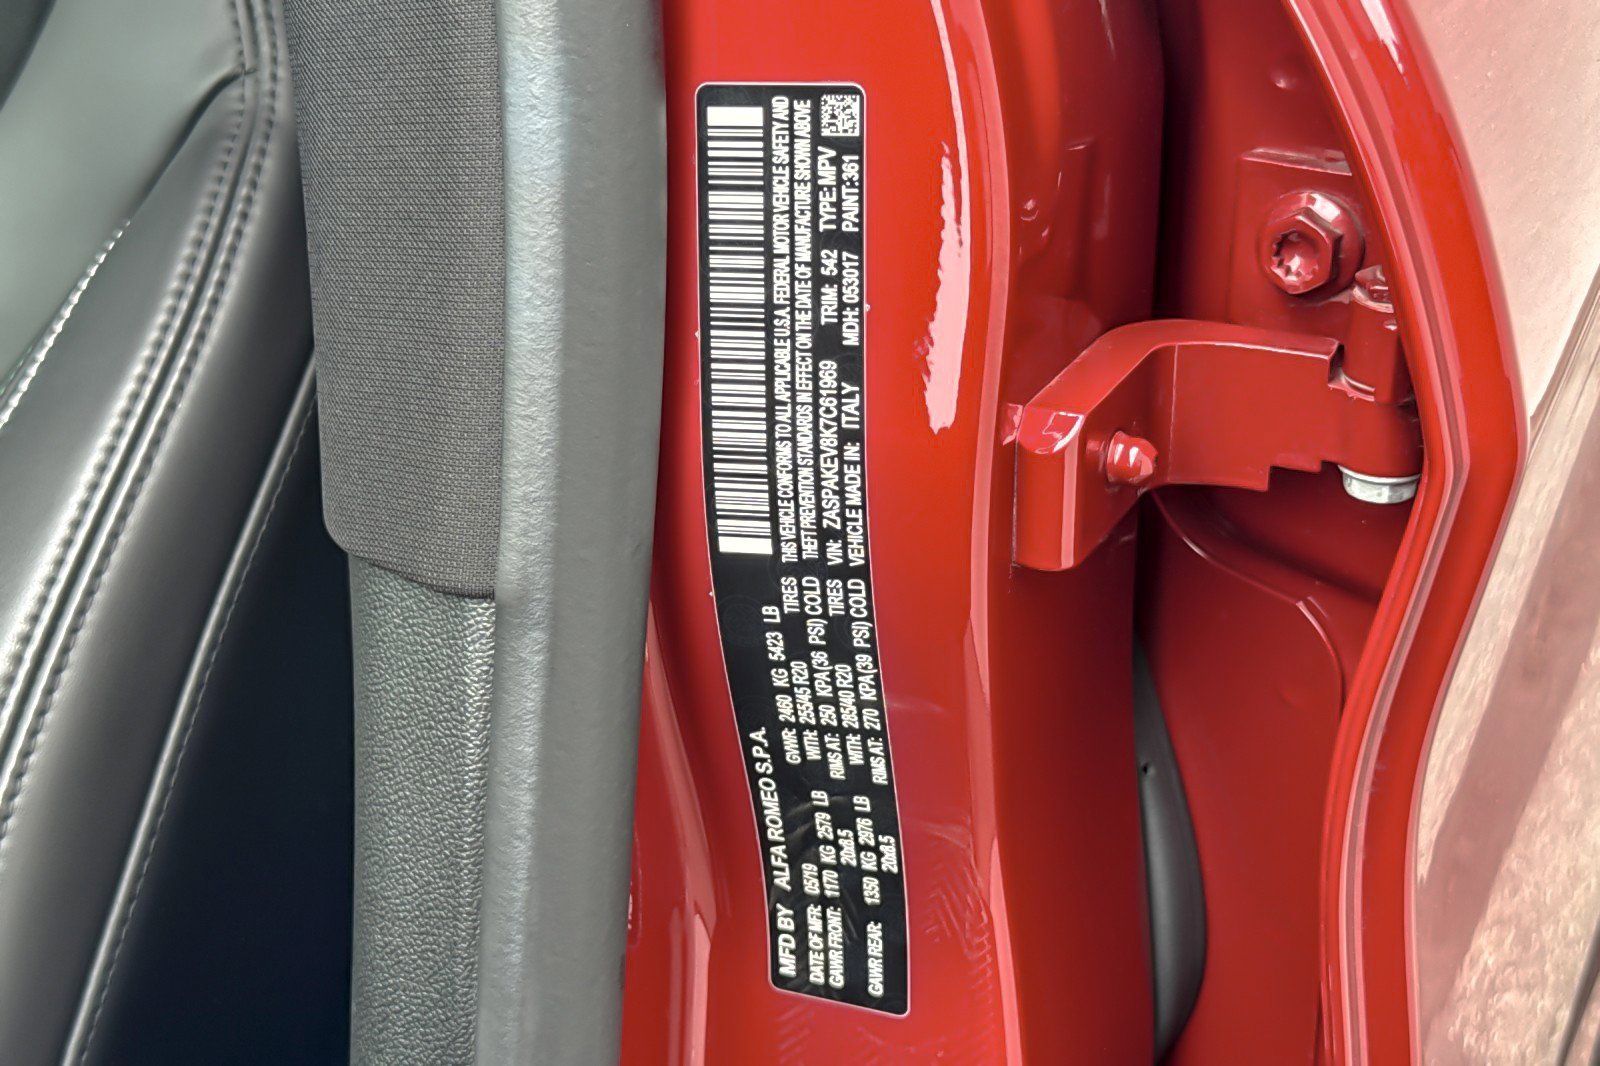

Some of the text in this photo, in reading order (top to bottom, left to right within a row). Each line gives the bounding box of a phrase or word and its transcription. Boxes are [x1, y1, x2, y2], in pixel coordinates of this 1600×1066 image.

[821, 249, 837, 276] 542
[842, 251, 859, 303] 053017
[822, 284, 838, 324] TRIM:
[772, 96, 798, 562] THIS VEHICLE CONFORMS TO ALL APPLICABLE U.S.A. FEDERAL MOTOR VEHICLE SAFETY AND
[794, 100, 818, 559] THEFT PREVENTION STANDARDS IN EFFECT ON THE DATE OF MANUFACTURE SHOWN ABOVE
[842, 308, 860, 346] MDH:
[819, 361, 844, 566] VIN: ZASPAKEV8K7C61969
[841, 382, 865, 566] VEHICLE MADE IN: ITALY
[782, 577, 800, 614] TIRES
[802, 577, 823, 615] COLD
[828, 579, 845, 616] TIRES
[848, 579, 868, 618] COLD
[762, 606, 802, 764] GVWR: 2460 KG 5423 LB
[791, 661, 809, 684] R20
[835, 664, 854, 688] R20
[820, 705, 838, 726] 250
[863, 709, 881, 730] 270
[804, 729, 822, 761] WITH:
[825, 733, 841, 752] AT:
[847, 733, 864, 765] WITH:
[868, 738, 884, 757] AT:
[828, 752, 846, 780] RIMS
[872, 757, 888, 785] RIMS
[749, 726, 796, 976] MFD BY ALFA ROMEO S.P.A.
[811, 791, 844, 987] GAWR FRONT: 1170 KG 2579 LB
[853, 796, 884, 996] GAWR REAR: 1350 KG 2976 LB
[803, 863, 824, 984] DATE OF MFR: 05/19
